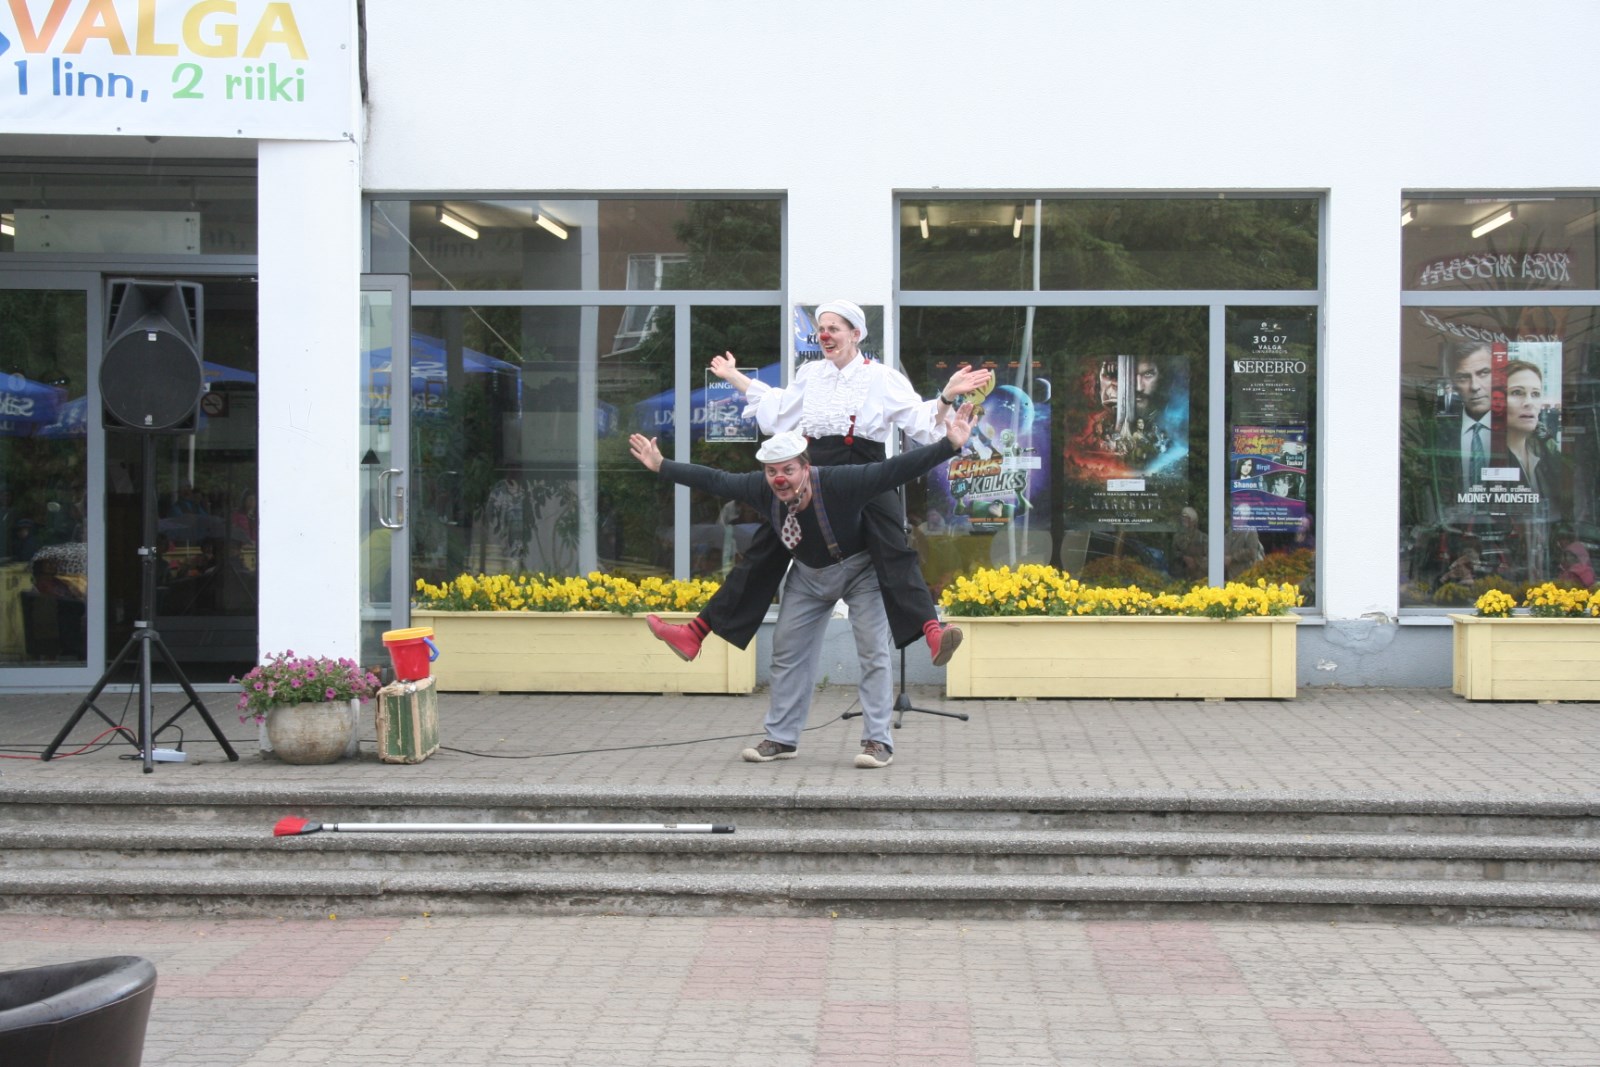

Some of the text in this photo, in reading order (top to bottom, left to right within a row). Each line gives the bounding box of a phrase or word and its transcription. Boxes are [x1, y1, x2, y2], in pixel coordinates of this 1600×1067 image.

[10, 0, 309, 60] VALGA
[14, 57, 305, 103] 1 linn, 2 riiki
[1238, 360, 1306, 374] SEREBRO
[1457, 492, 1540, 503] MONEY MONSTER
